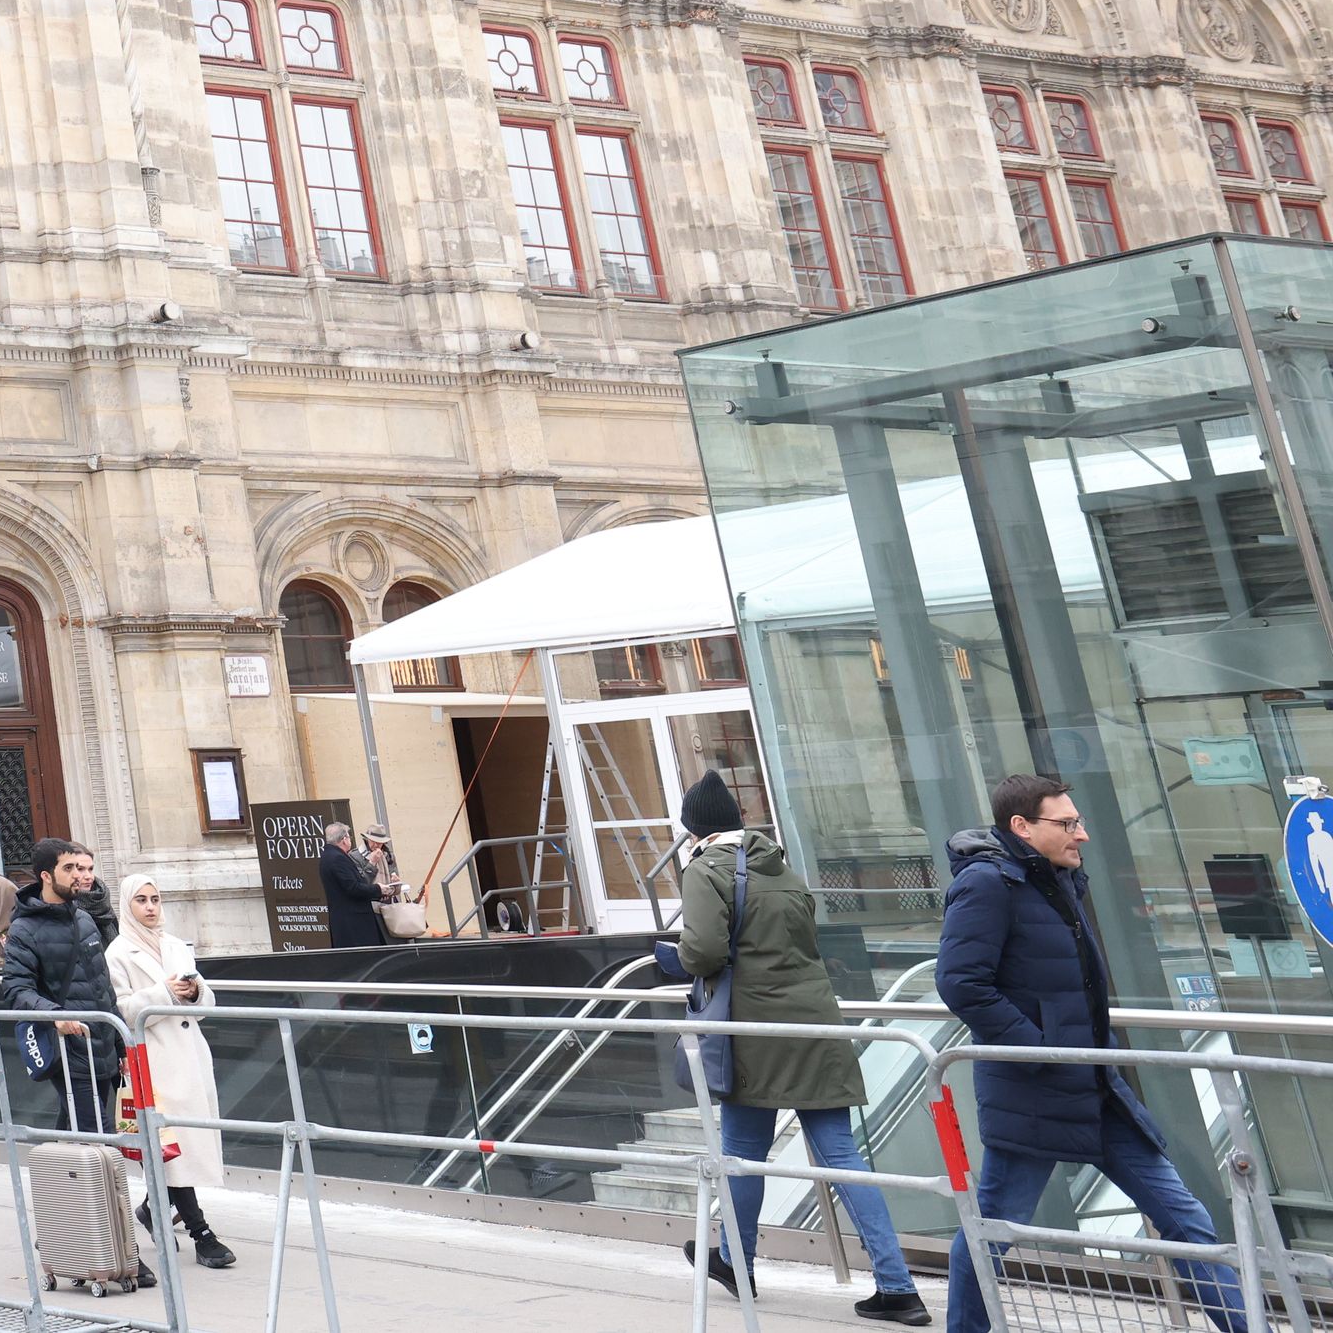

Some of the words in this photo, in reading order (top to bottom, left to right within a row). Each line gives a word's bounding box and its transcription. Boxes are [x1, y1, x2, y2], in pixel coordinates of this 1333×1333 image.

[263, 815, 325, 839] OPERN
[266, 837, 326, 860] FOYER
[272, 875, 303, 890] Tickets
[279, 924, 312, 932] VOLKSOPER
[25, 1025, 45, 1068] adidas
